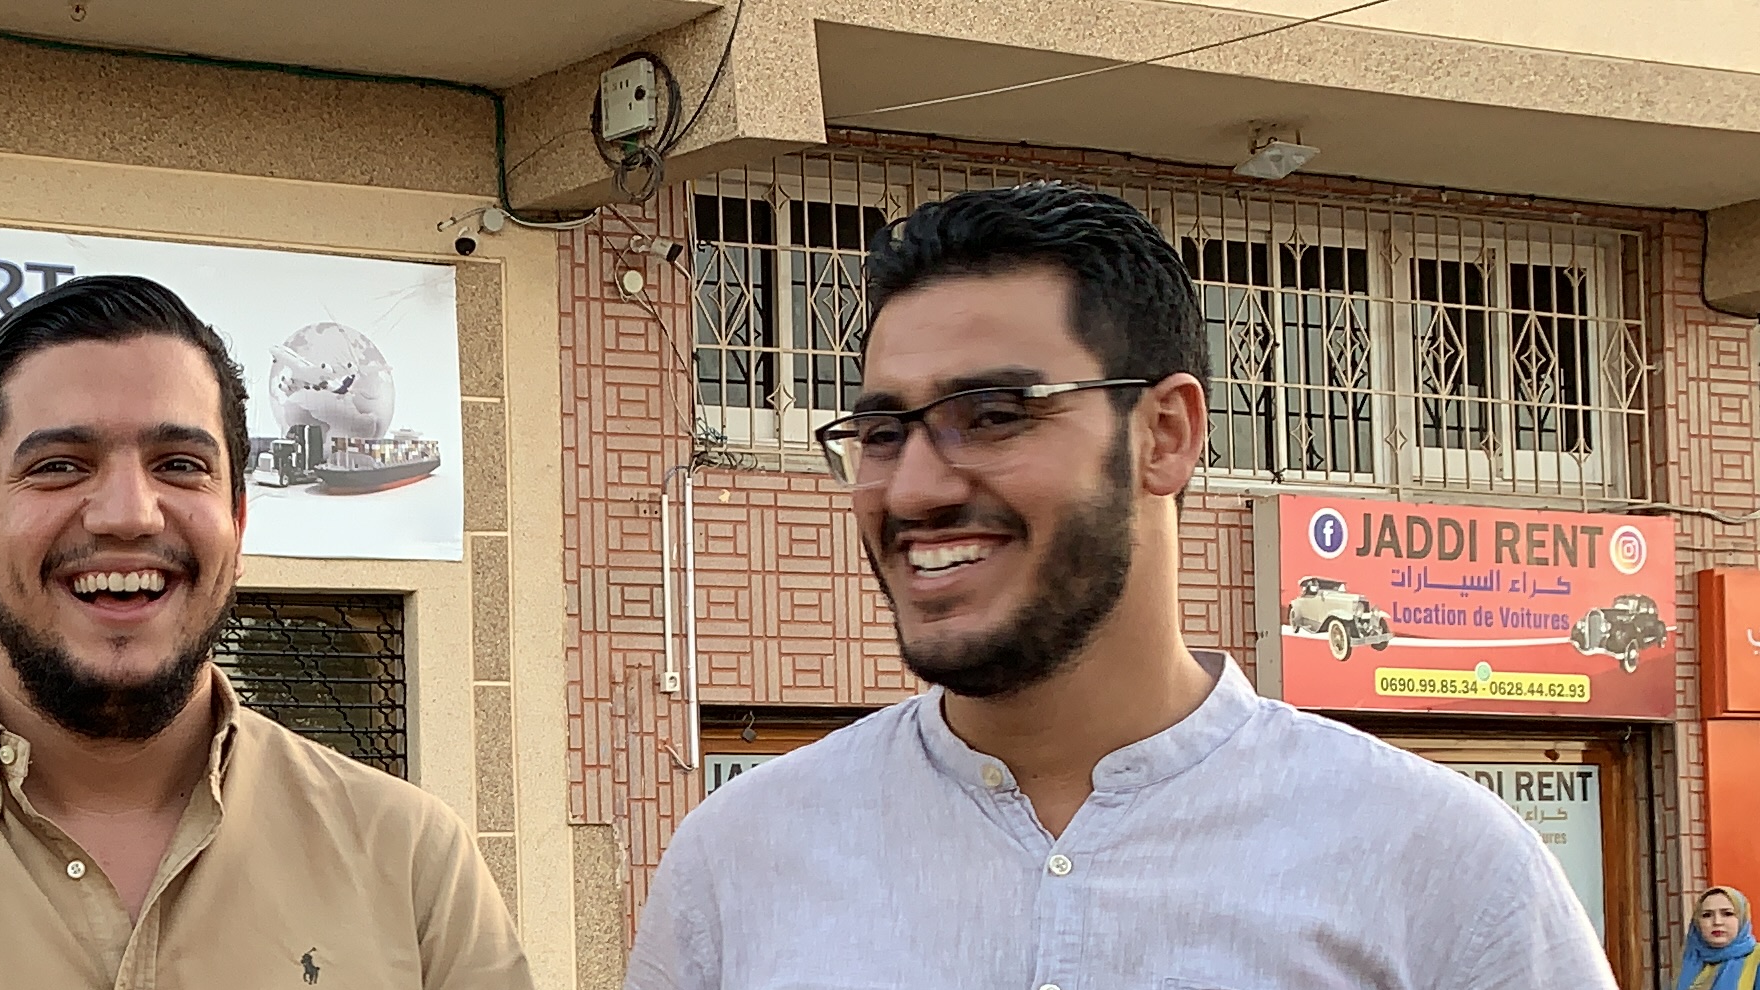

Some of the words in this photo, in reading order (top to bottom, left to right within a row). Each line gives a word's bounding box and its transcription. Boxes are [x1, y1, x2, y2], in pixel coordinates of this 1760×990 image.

[1355, 513, 1478, 563] JADDI
[1494, 520, 1604, 569] RENT
[1392, 602, 1467, 628] Location
[1473, 606, 1494, 627] de
[1500, 609, 1571, 631] Voitures
[1380, 676, 1479, 696] 0690.99.85.34
[1489, 681, 1586, 699] 0628.44.62.93
[1515, 771, 1593, 801] RENT
